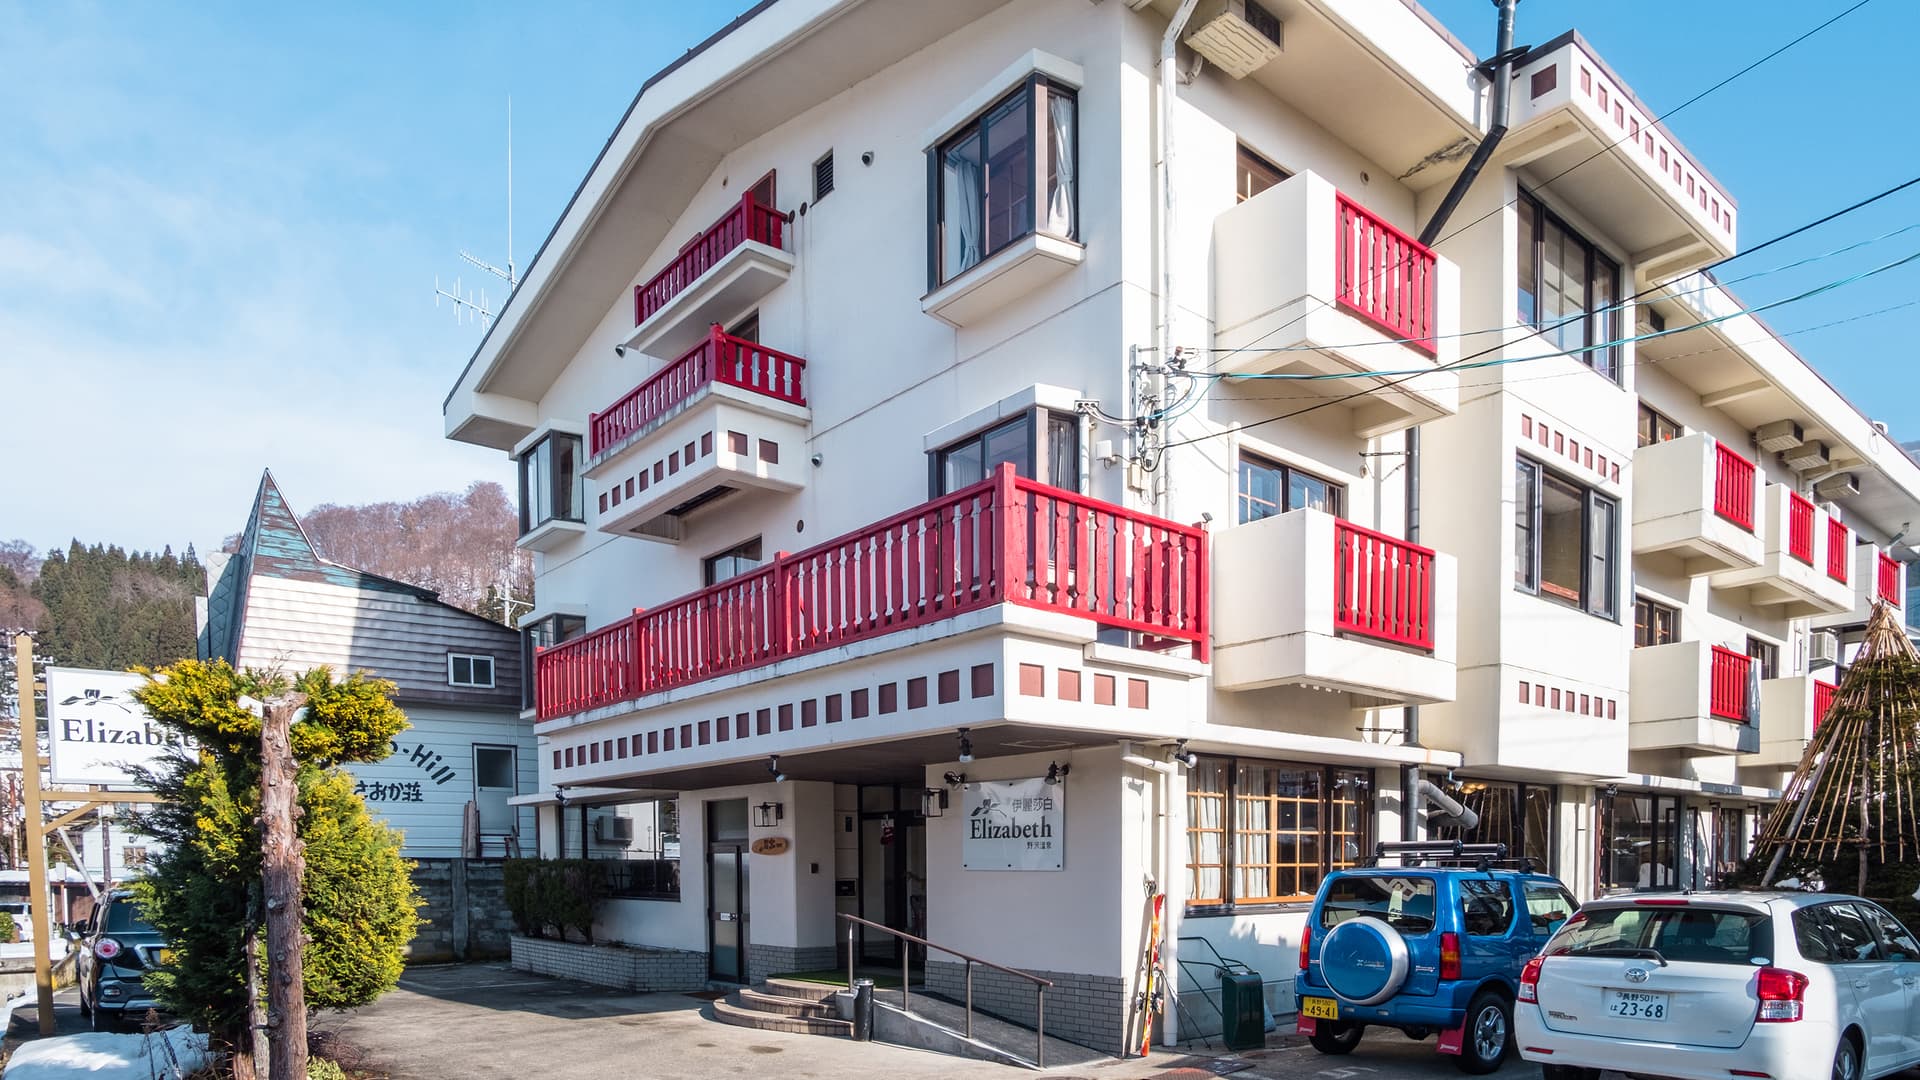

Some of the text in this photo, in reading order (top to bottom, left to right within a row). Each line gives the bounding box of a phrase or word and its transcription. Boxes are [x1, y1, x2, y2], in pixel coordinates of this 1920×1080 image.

[59, 718, 200, 747] Elizabet
[970, 815, 1053, 840] Elizabeth
[1619, 1001, 1664, 1018] 23-68
